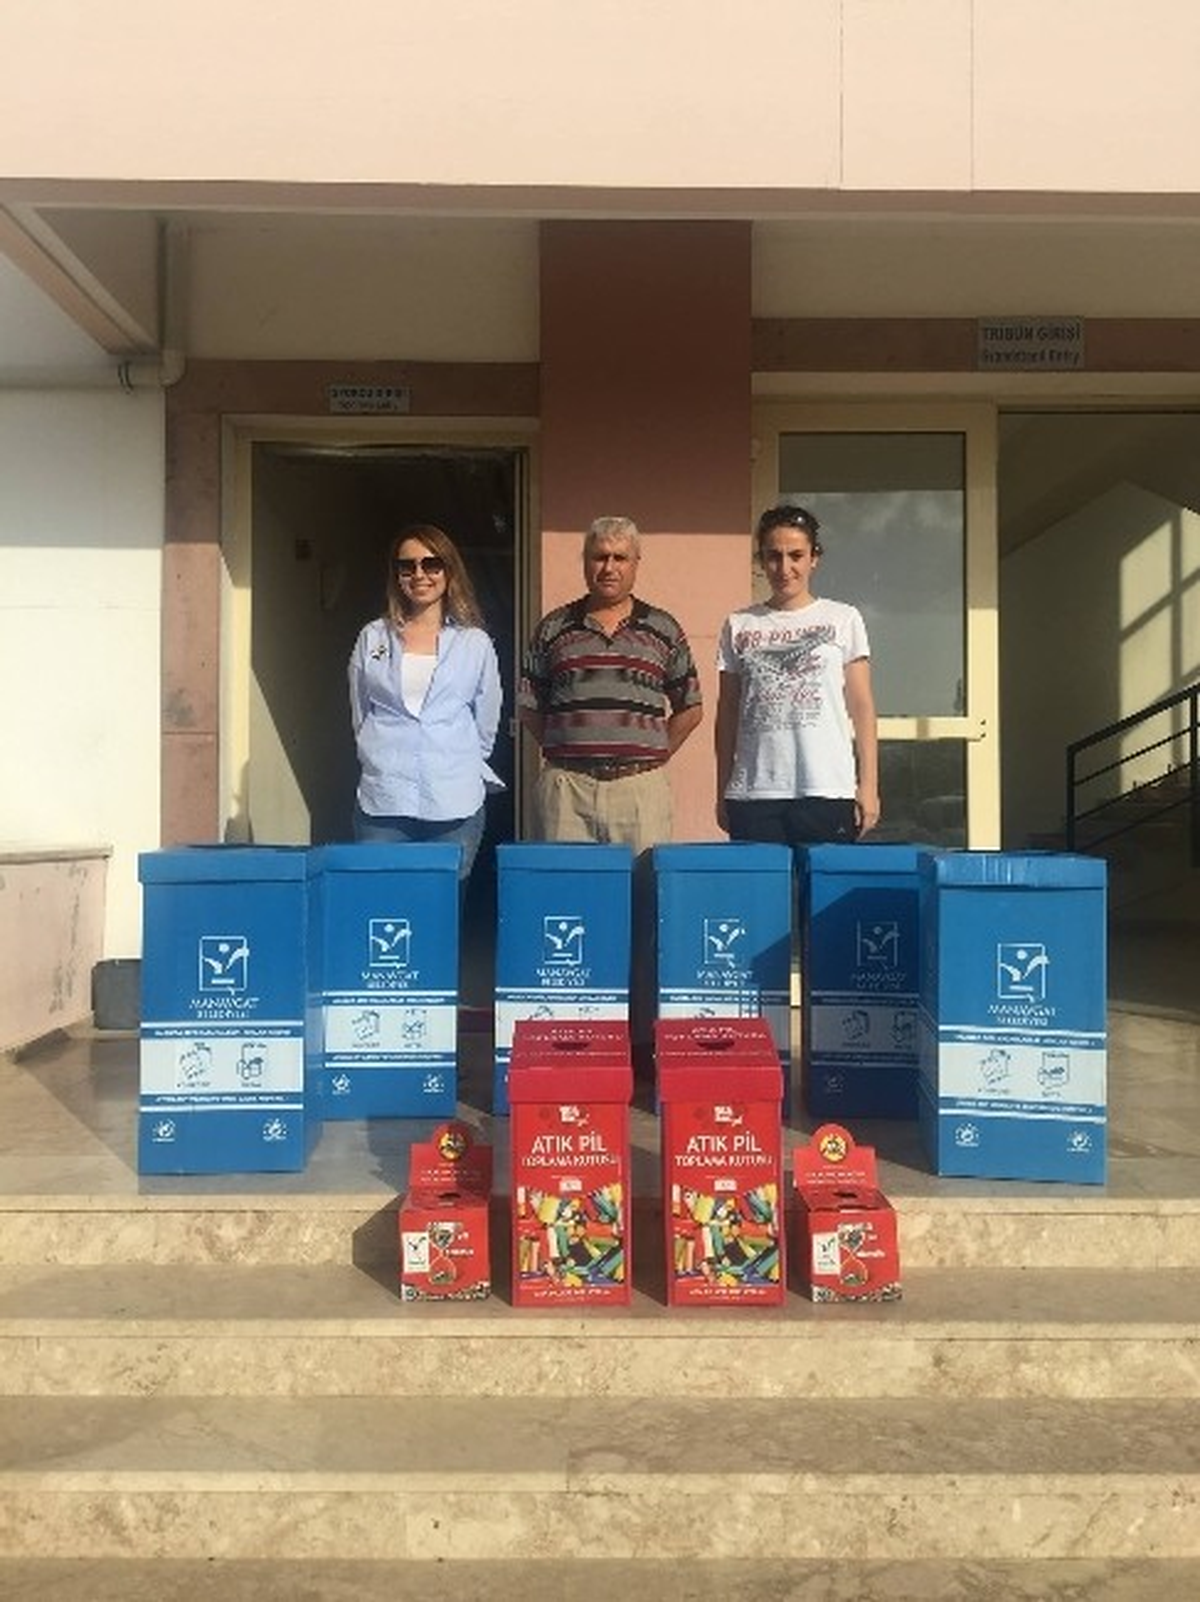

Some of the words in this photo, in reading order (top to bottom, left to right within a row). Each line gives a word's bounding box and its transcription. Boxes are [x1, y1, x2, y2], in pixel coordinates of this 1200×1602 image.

[531, 1134, 573, 1154] ATIK
[579, 1130, 608, 1153] PİL
[686, 1134, 728, 1154] ATIK
[733, 1130, 763, 1153] PİL
